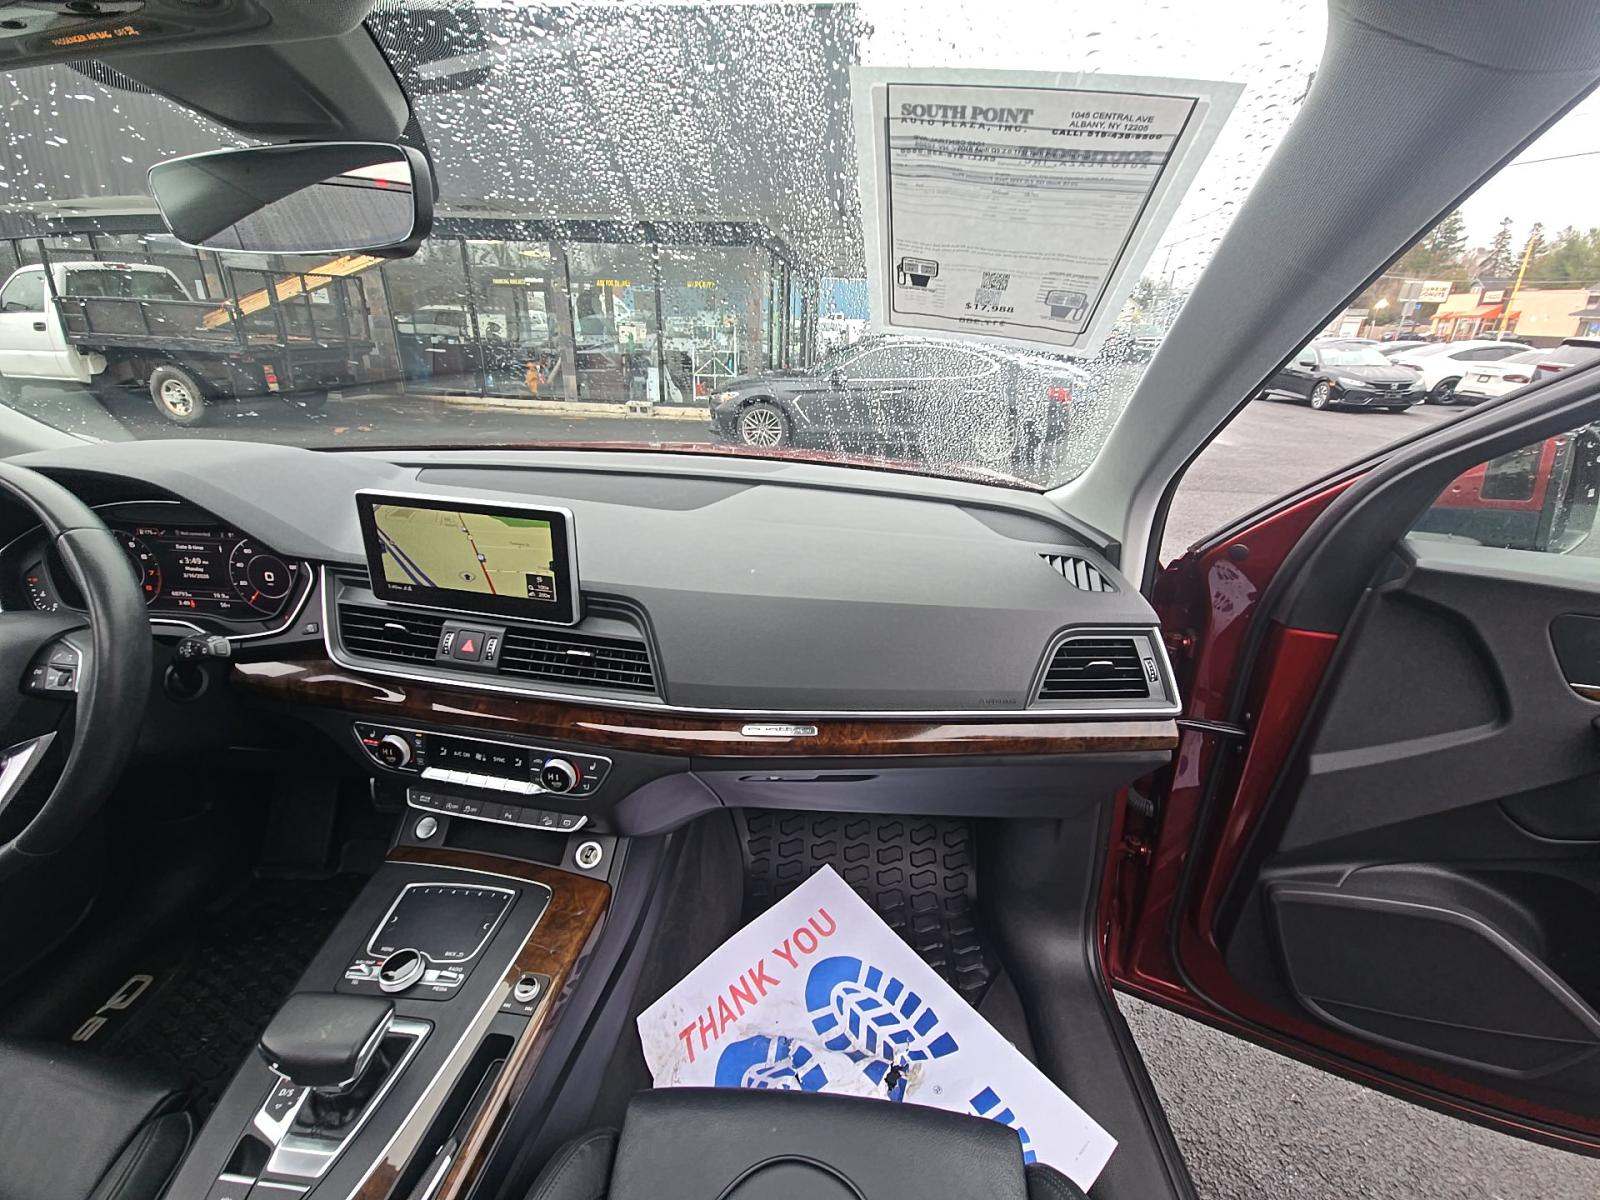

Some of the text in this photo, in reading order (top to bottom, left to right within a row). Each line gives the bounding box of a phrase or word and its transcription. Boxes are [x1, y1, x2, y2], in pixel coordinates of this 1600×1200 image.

[901, 103, 1034, 124] SOUTH POINT
[1092, 111, 1134, 121] CENTRAL
[1135, 115, 1155, 123] AVE
[901, 117, 935, 126] AUTO
[1108, 122, 1121, 130] NY
[965, 302, 1015, 313] $17,988
[264, 571, 275, 582] 0
[678, 907, 837, 1064] THANK YOU
